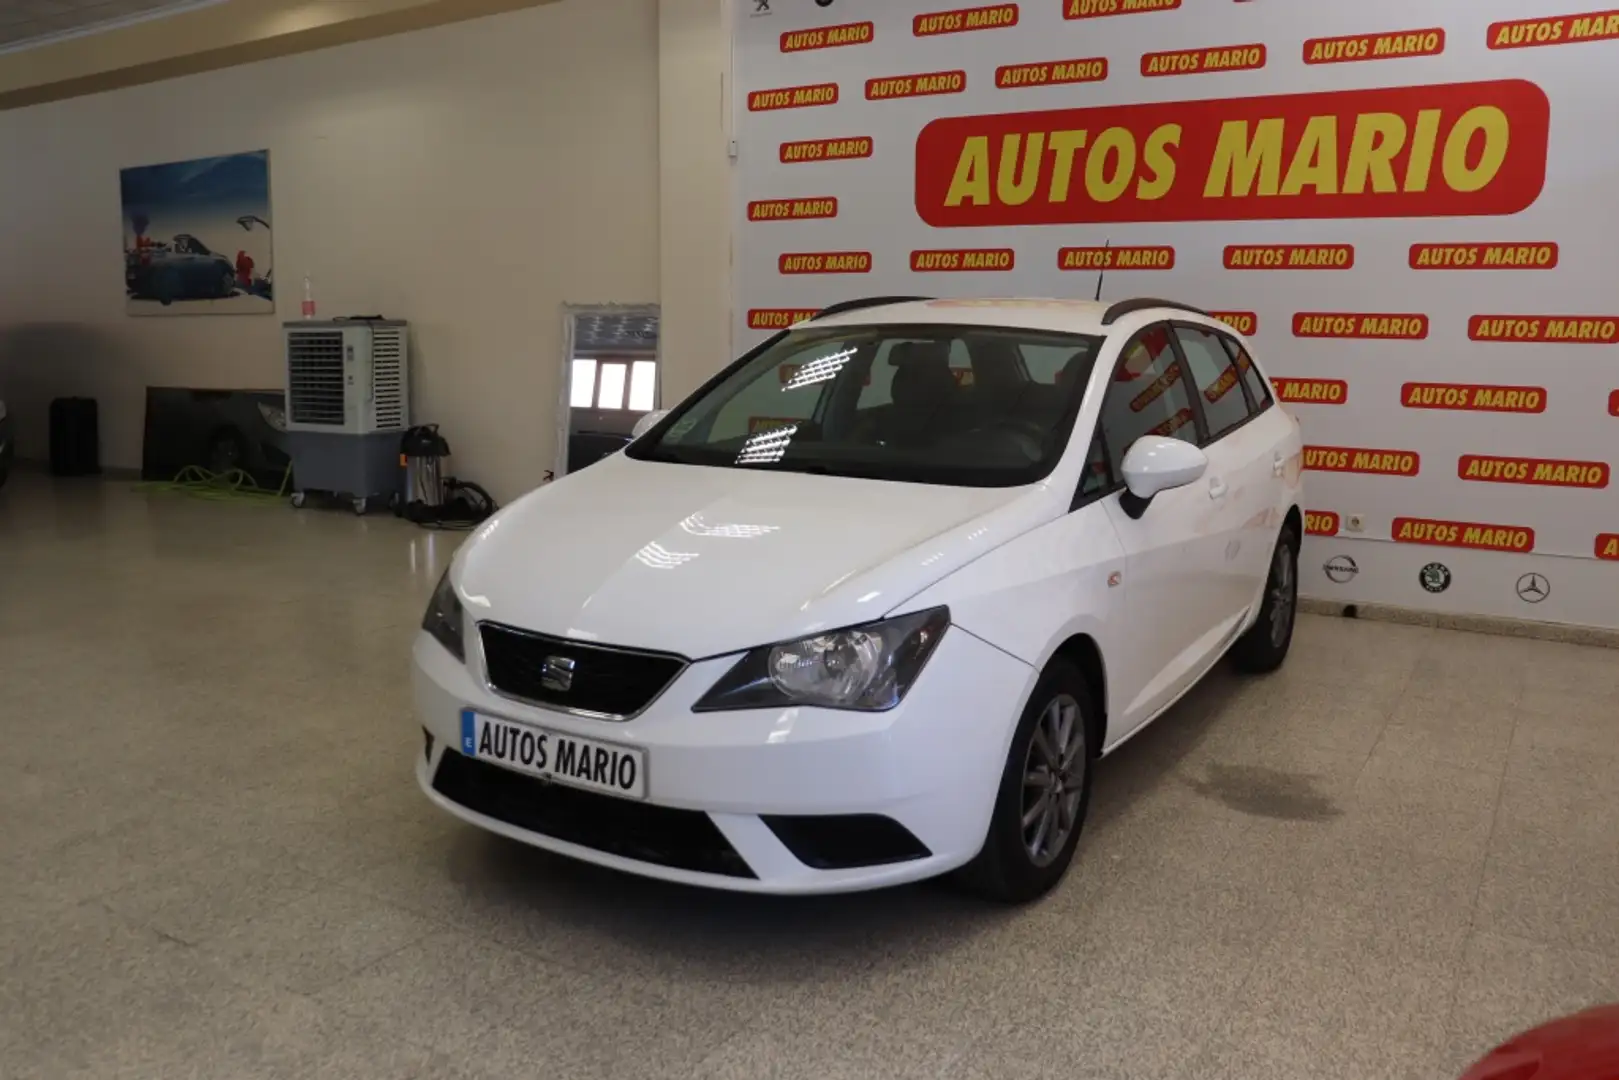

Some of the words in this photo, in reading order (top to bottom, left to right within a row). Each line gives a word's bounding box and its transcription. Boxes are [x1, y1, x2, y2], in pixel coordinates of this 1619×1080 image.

[1069, 0, 1117, 16] AUTOS
[918, 14, 962, 33] AUTOS
[966, 8, 1014, 26] MARIO
[1495, 21, 1564, 45] AUTOS
[1568, 14, 1619, 37] MAR
[787, 32, 824, 49] AUTOS
[826, 25, 869, 43] MARIO
[1311, 39, 1369, 59] AUTOS
[1373, 32, 1439, 55] MARIO
[1148, 53, 1199, 72] AUTOS
[1203, 47, 1261, 68] MARIO
[1002, 67, 1048, 84] AUTOS
[1052, 61, 1103, 80] MARIO
[871, 79, 913, 96] AUTOS
[915, 76, 961, 91] MARIO
[753, 92, 790, 108] AUTOS
[793, 87, 834, 104] MARIO
[785, 143, 823, 160] AUTOS
[825, 139, 869, 156] MARIO
[943, 123, 1182, 207] AUTOS
[1203, 104, 1510, 198] MARIO
[753, 203, 789, 217] AUTOS
[793, 202, 833, 217] MARIO
[783, 255, 822, 270] AUTOS
[824, 255, 867, 269] MARIO
[916, 253, 959, 267] AUTOS
[963, 252, 1010, 268] MARIO
[1065, 250, 1113, 266] AUTOS
[1116, 250, 1169, 266] MARIO
[1231, 248, 1285, 265] AUTOS
[1289, 248, 1348, 266] MARIO
[1417, 247, 1477, 265] AUTOS
[1483, 246, 1551, 265] MARIO
[752, 312, 789, 325] AUTOS
[1214, 315, 1252, 332] RIO
[1300, 317, 1355, 334] AUTOS
[1359, 318, 1422, 335] MARIO
[1477, 319, 1539, 337] AUTOS
[1545, 319, 1617, 339] MARIO
[1283, 382, 1342, 400] MARIO
[1408, 387, 1469, 406] AUTOS
[1473, 389, 1540, 409] MARIO
[1352, 453, 1413, 472] MARIO
[1466, 460, 1529, 479] AUTOS
[1533, 463, 1602, 483] MARIO
[1304, 515, 1333, 531] RIO
[1400, 522, 1457, 541] AUTOS
[1463, 527, 1528, 547] MARIO
[464, 736, 473, 748] E
[479, 721, 548, 769] AUTOS
[554, 739, 636, 790] MARIO
